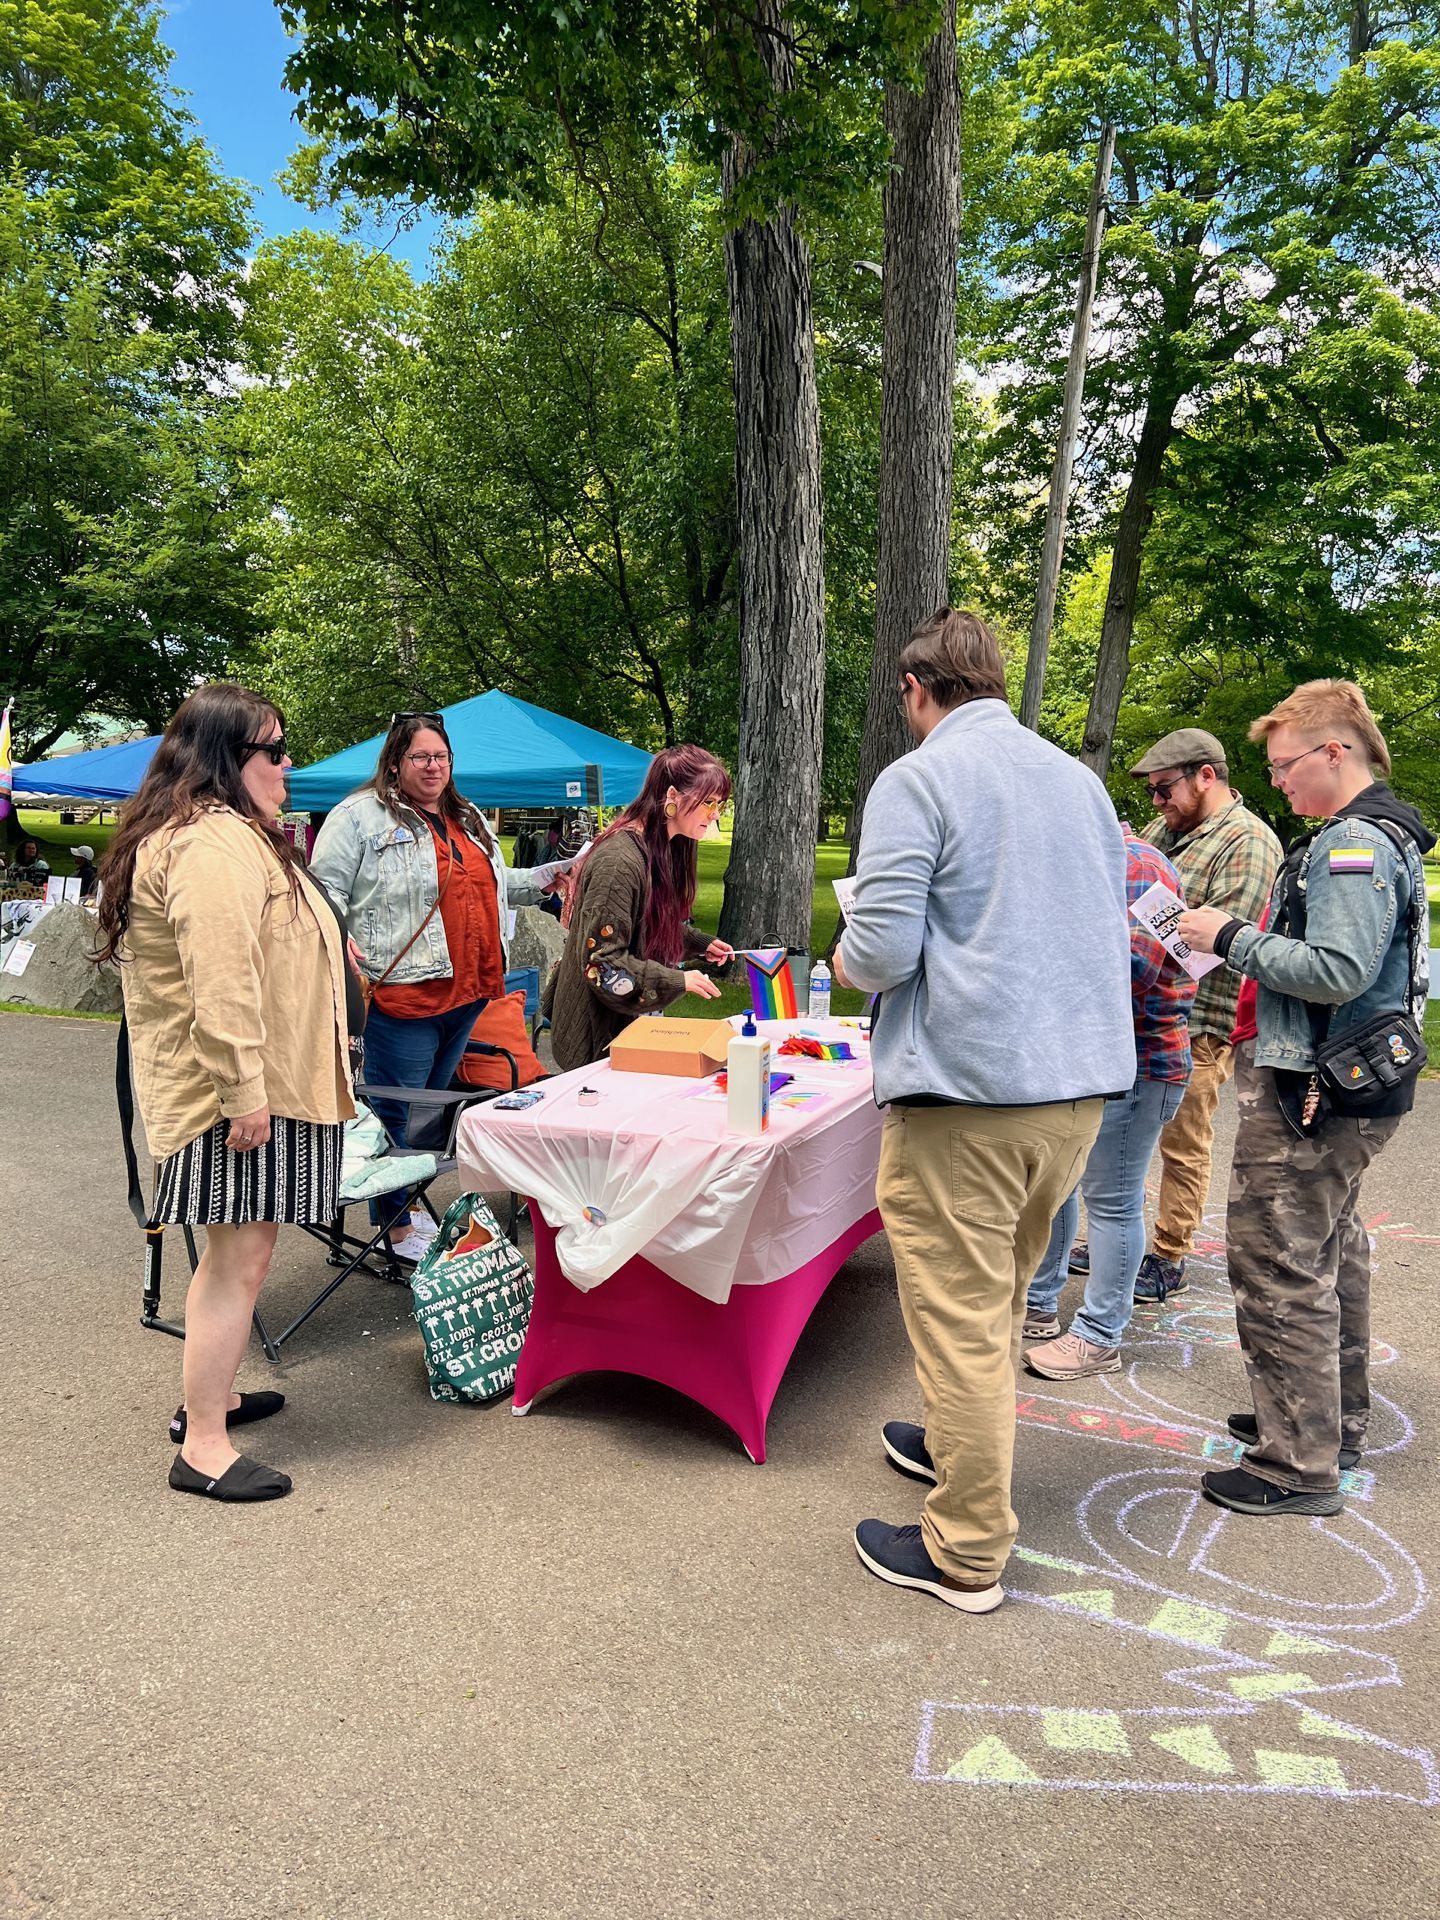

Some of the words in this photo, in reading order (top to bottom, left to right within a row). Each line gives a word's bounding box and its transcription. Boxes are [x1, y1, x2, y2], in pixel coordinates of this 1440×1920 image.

[415, 1246, 521, 1301] ST.THOMAS
[462, 1278, 500, 1300] ST.THOMAS
[481, 1322, 514, 1343] CROIX
[1016, 1397, 1191, 1451] LOVE
